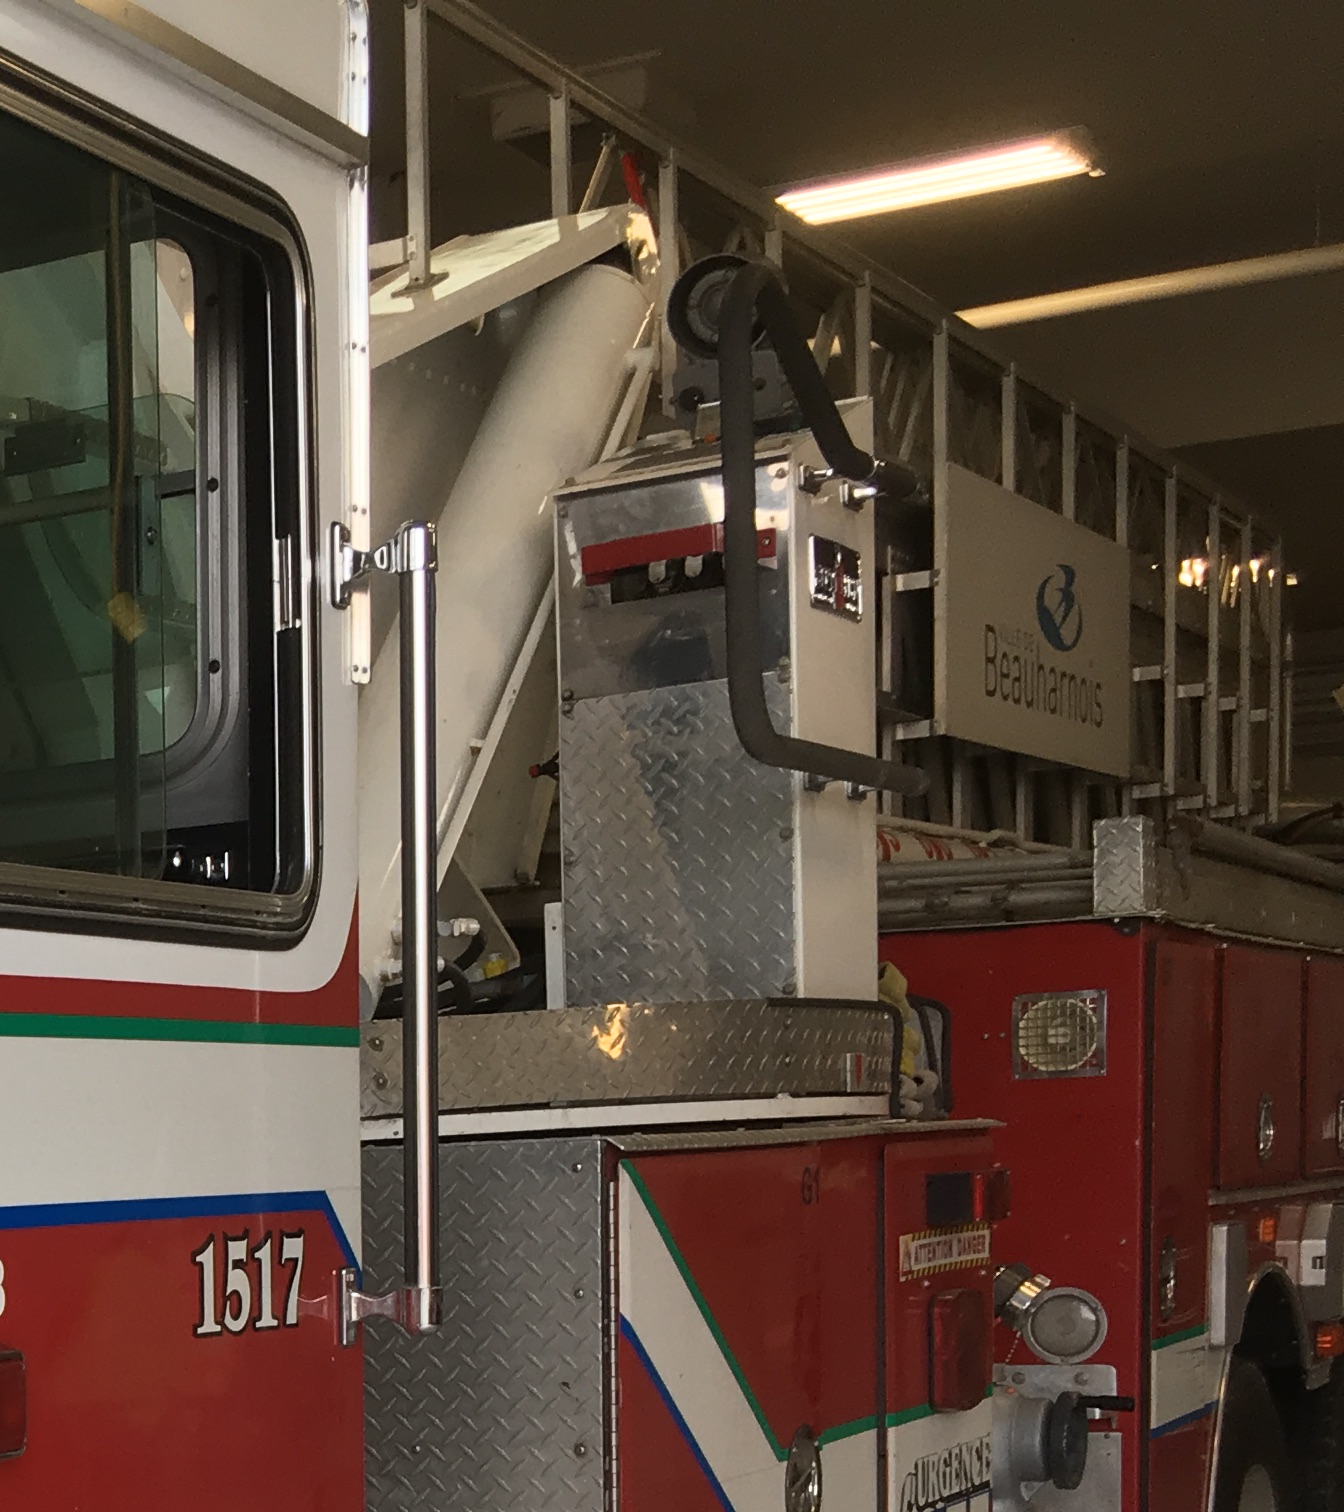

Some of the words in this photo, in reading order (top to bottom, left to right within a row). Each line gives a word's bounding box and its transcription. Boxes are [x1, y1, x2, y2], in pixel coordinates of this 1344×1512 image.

[985, 624, 1103, 728] Beauharnois
[193, 1229, 305, 1337] 1517
[914, 1238, 953, 1266] ATTENTION
[957, 1233, 986, 1257] DANGER
[914, 1432, 992, 1508] URGENCE
